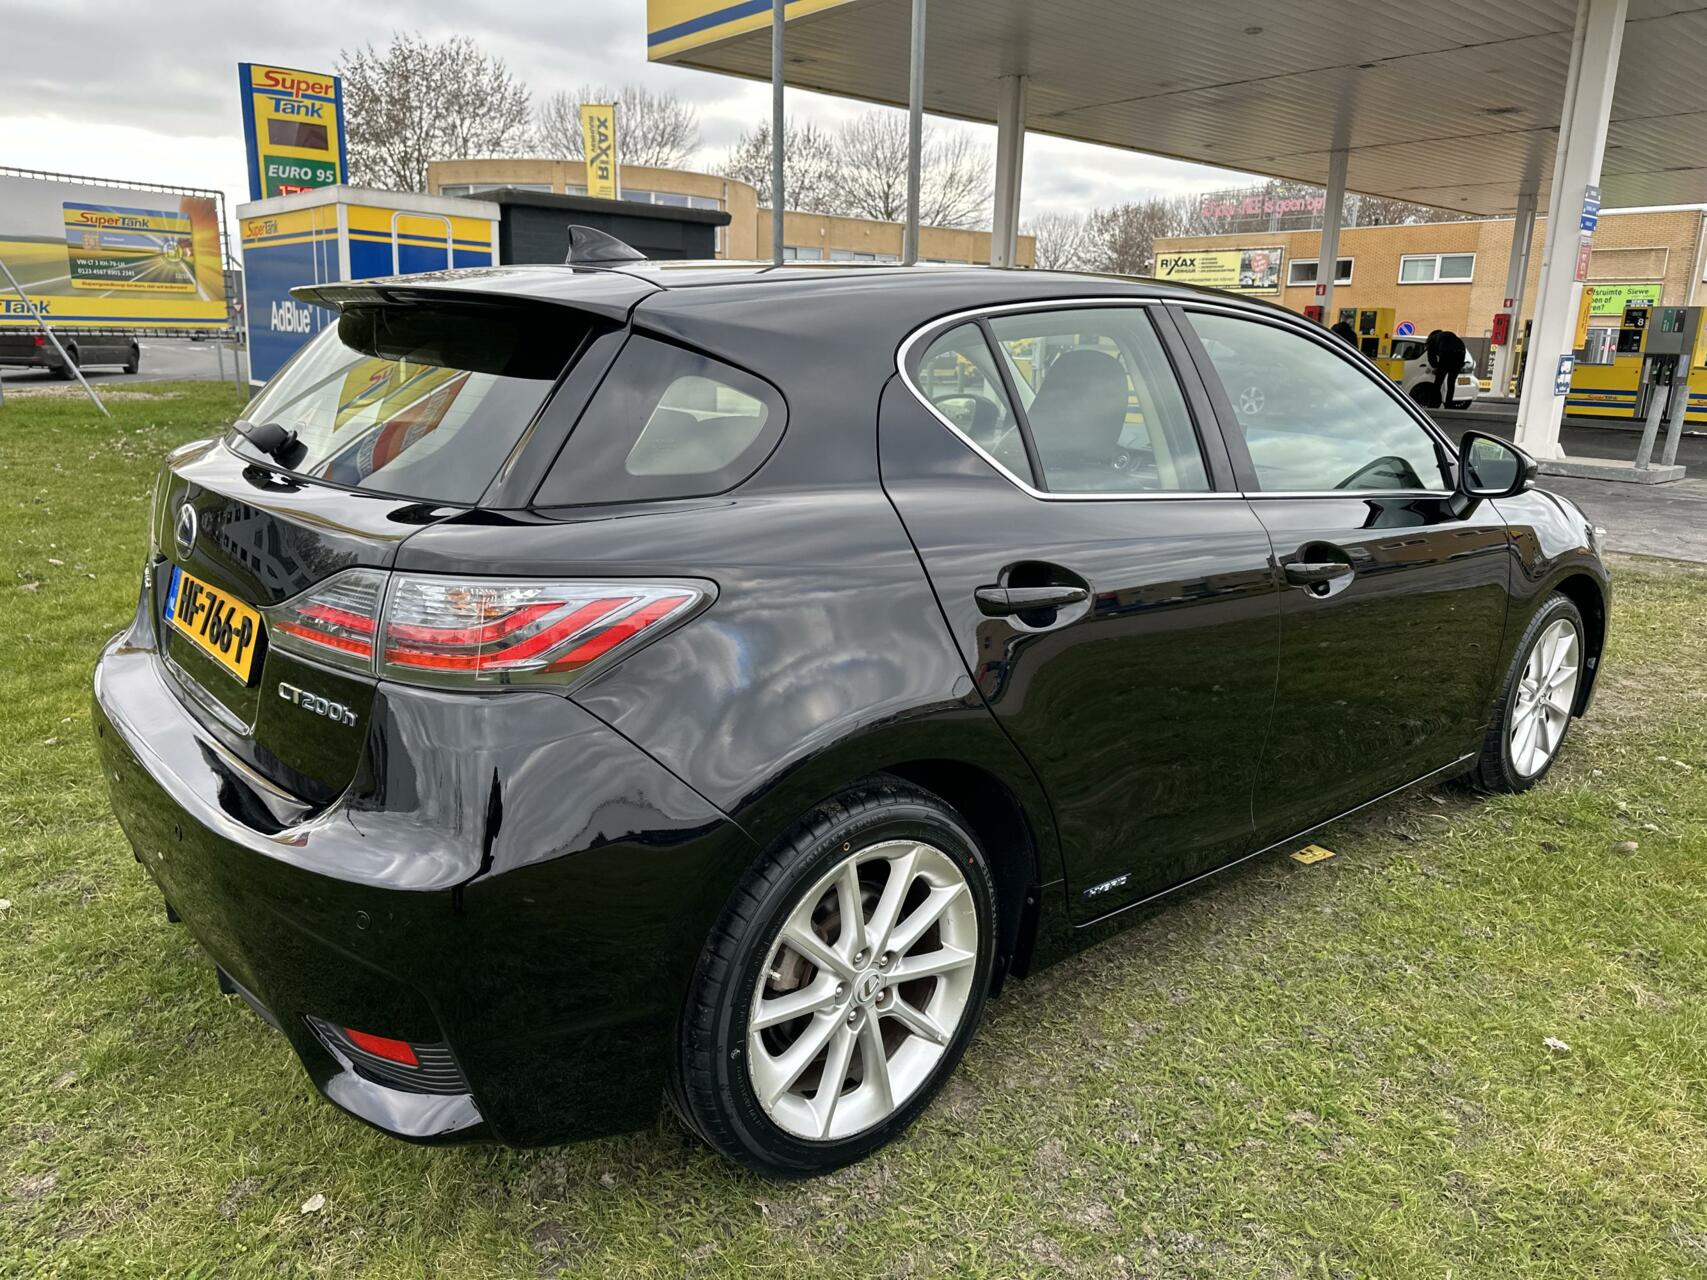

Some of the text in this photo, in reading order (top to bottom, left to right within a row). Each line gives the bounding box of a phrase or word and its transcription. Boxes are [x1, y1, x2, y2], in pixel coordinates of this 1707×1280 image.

[252, 70, 333, 98] Super
[266, 96, 323, 118] Tank
[268, 164, 335, 182] EURO 95
[75, 212, 149, 229] SuperTank
[246, 220, 279, 242] SuperTank
[1160, 256, 1197, 276] RIXAX
[271, 300, 311, 333] AdBlue
[1637, 318, 1645, 327] 8
[178, 577, 253, 665] HF-766-P
[278, 682, 357, 727] CT200h
